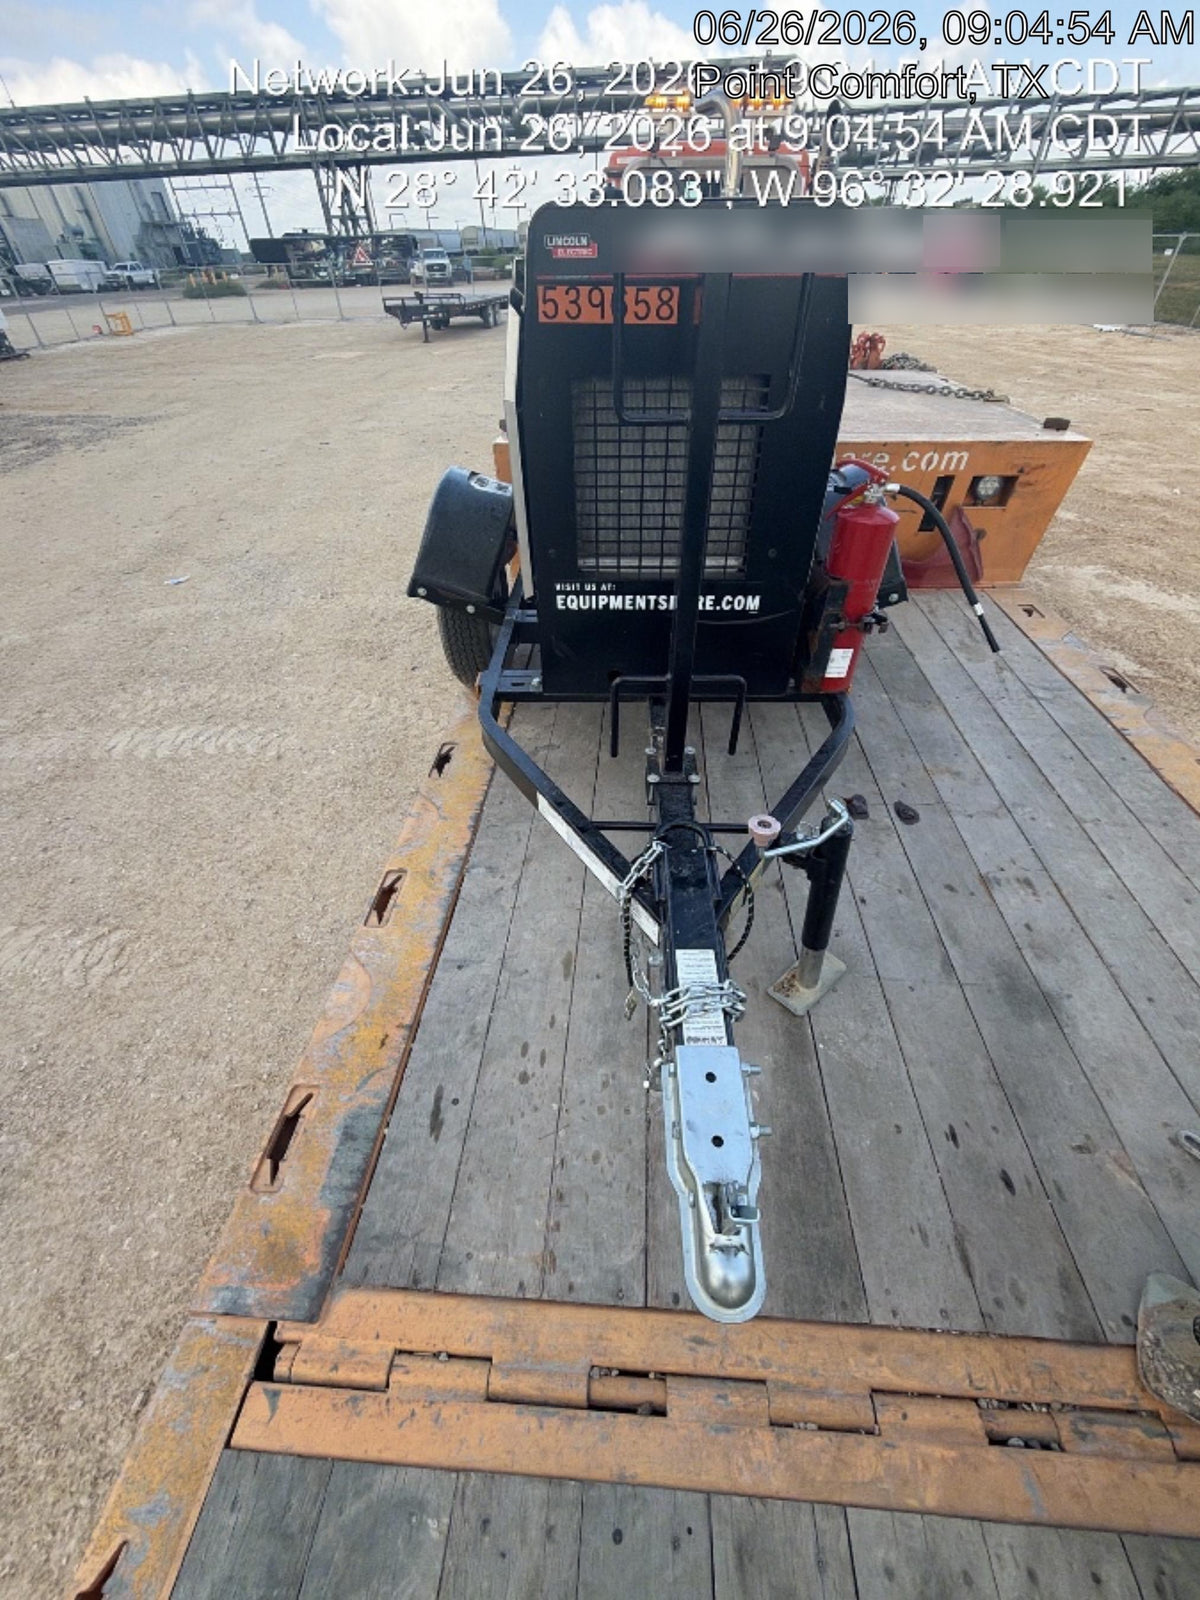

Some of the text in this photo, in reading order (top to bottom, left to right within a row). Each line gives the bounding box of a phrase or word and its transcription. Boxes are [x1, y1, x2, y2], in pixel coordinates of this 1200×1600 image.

[547, 236, 588, 246] LINCOLN
[555, 582, 617, 591] VISIT US AT:
